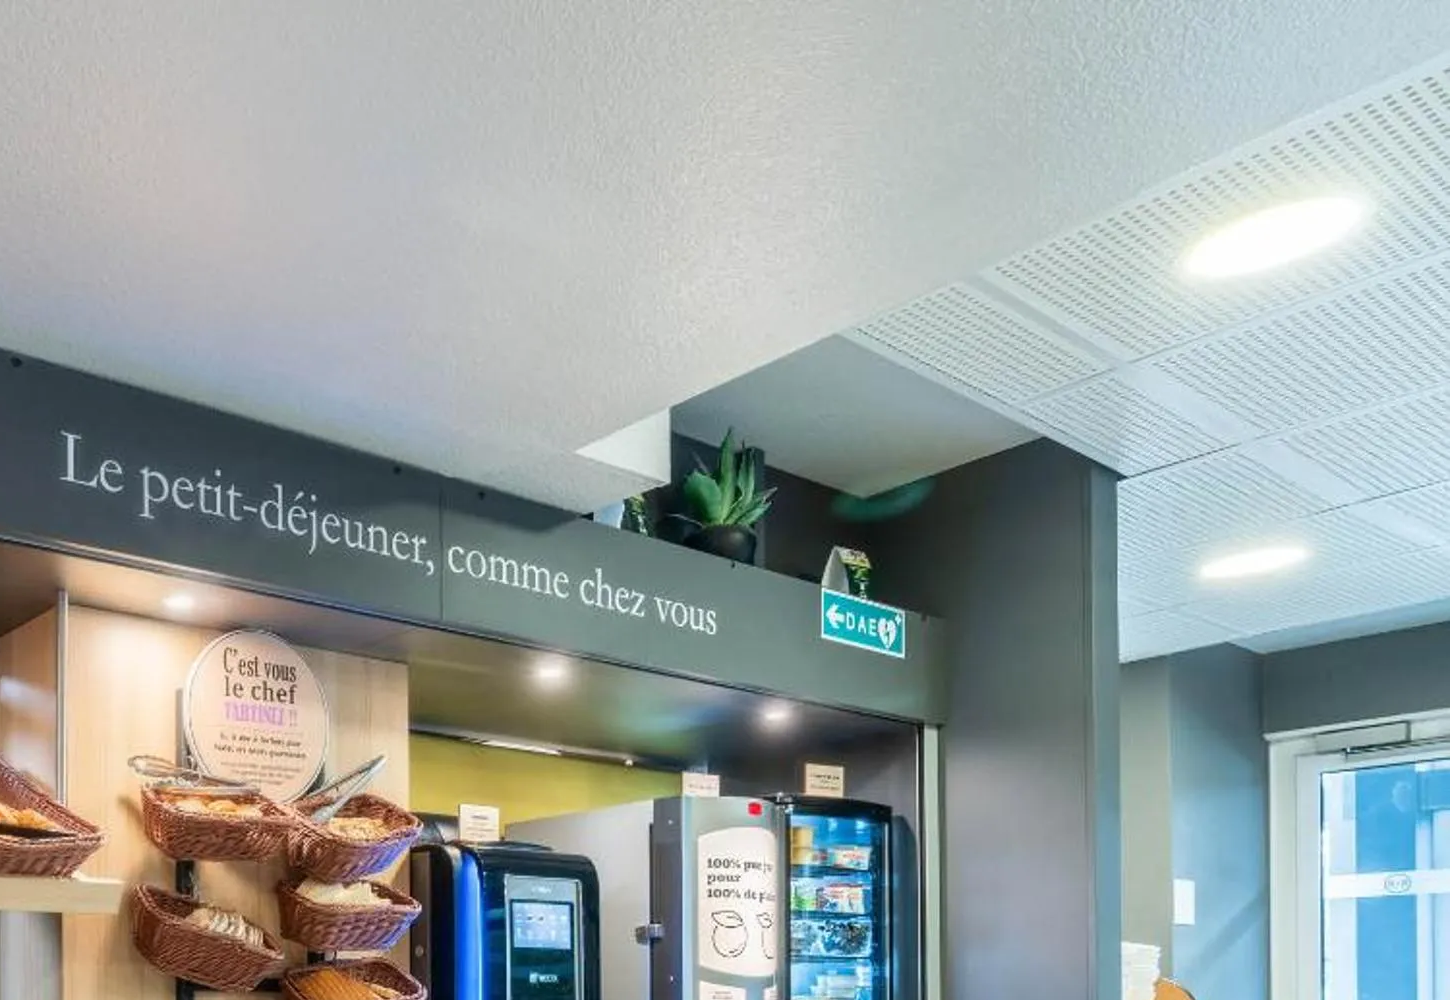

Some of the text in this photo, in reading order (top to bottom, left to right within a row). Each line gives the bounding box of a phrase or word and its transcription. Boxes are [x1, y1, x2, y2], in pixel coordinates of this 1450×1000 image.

[59, 430, 717, 636] Le petit-déjeuner, comme chez vous
[846, 611, 878, 638] DAE
[223, 647, 297, 683] C'est vous
[224, 675, 298, 705] le chef
[706, 858, 741, 869] 100%
[706, 874, 741, 886] pour
[706, 888, 741, 899] 100%
